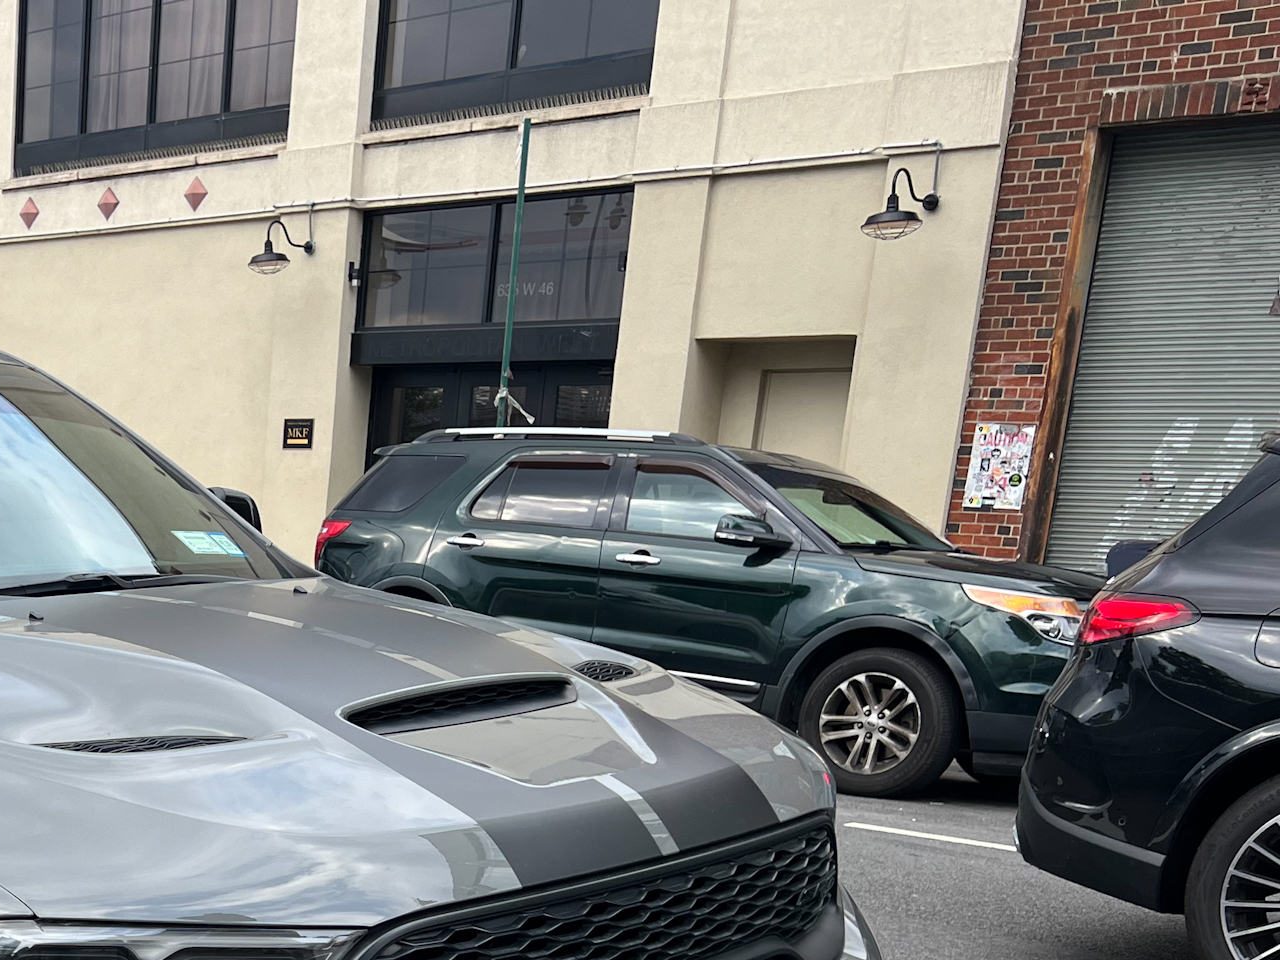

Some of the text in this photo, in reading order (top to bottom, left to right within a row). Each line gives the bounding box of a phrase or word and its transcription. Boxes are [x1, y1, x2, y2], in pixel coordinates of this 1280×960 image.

[523, 282, 536, 296] W
[538, 281, 554, 296] 46
[287, 427, 309, 438] MKF
